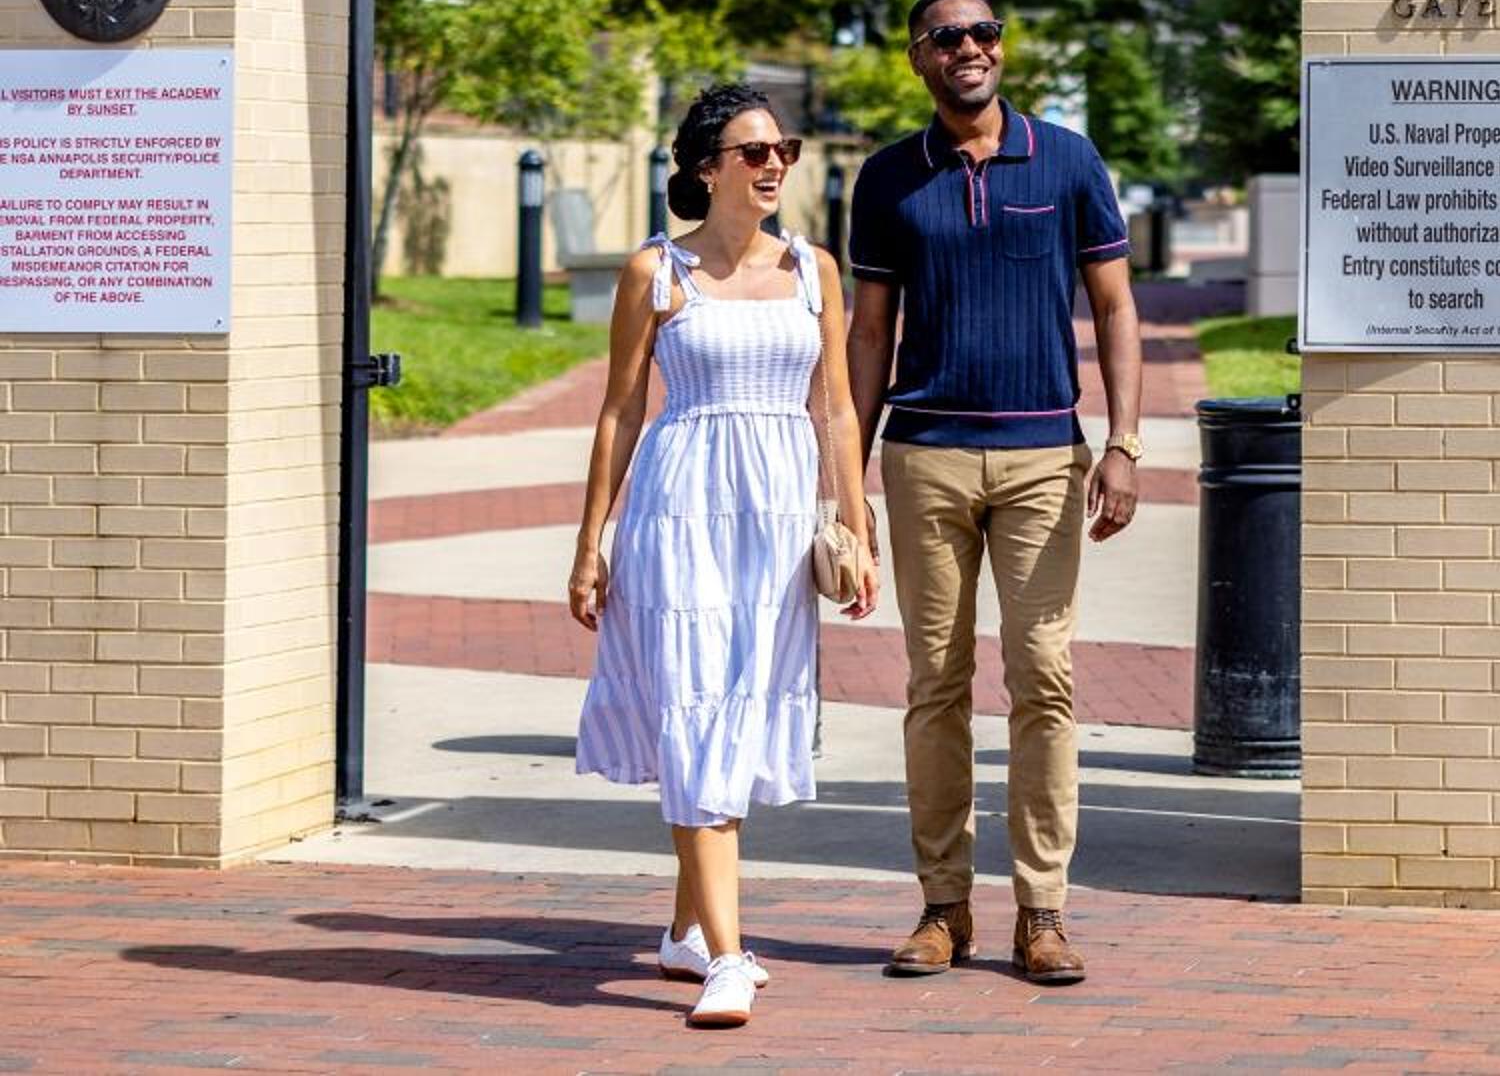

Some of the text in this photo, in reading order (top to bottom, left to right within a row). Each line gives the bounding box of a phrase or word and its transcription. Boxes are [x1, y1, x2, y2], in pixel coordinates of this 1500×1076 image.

[12, 89, 66, 99] VISITORS
[69, 89, 100, 99] MUST
[106, 89, 131, 99] EXIT
[135, 89, 157, 99] THE
[161, 89, 220, 99] ACADEMY
[1392, 80, 1500, 100] WARNING
[67, 104, 81, 115] BY
[1369, 124, 1399, 144] U.S.
[1405, 124, 1449, 144] Naval
[14, 138, 56, 148] POLICY
[61, 138, 71, 148] IS
[76, 138, 131, 148] STRICTLY
[136, 138, 202, 148] ENFORCED
[206, 138, 220, 148] BY
[12, 154, 35, 164] NSA
[39, 154, 108, 164] ANNAPOLIS
[112, 154, 220, 164] SECURITY/POLICE
[1345, 156, 1388, 177] Video
[1394, 156, 1494, 177] Surveillance
[1, 200, 208, 210] AILURE TO COMPLY MAY RESULT IN
[1322, 190, 1380, 210] Federal
[1387, 190, 1420, 210] Law
[1426, 190, 1497, 213] prohibits
[50, 215, 83, 226] FROM
[88, 215, 142, 226] FEDERAL
[15, 231, 186, 241] BARMENT FROM ACCESSING
[1357, 223, 1418, 243] without
[0, 246, 73, 257] STALLATION
[143, 246, 151, 257] A
[156, 246, 212, 257] FEDERAL
[12, 261, 189, 272] MISDEMEANOR CITATION FOR
[1343, 255, 1384, 280] Entry
[1389, 255, 1480, 277] constitutes
[78, 277, 96, 287] OR
[99, 277, 123, 287] ANY
[127, 277, 212, 287] COMBINATION
[54, 292, 71, 302] OF
[74, 292, 96, 302] THE
[1409, 289, 1483, 309] to search
[1461, 325, 1480, 336] Act
[1482, 325, 1495, 336] of
